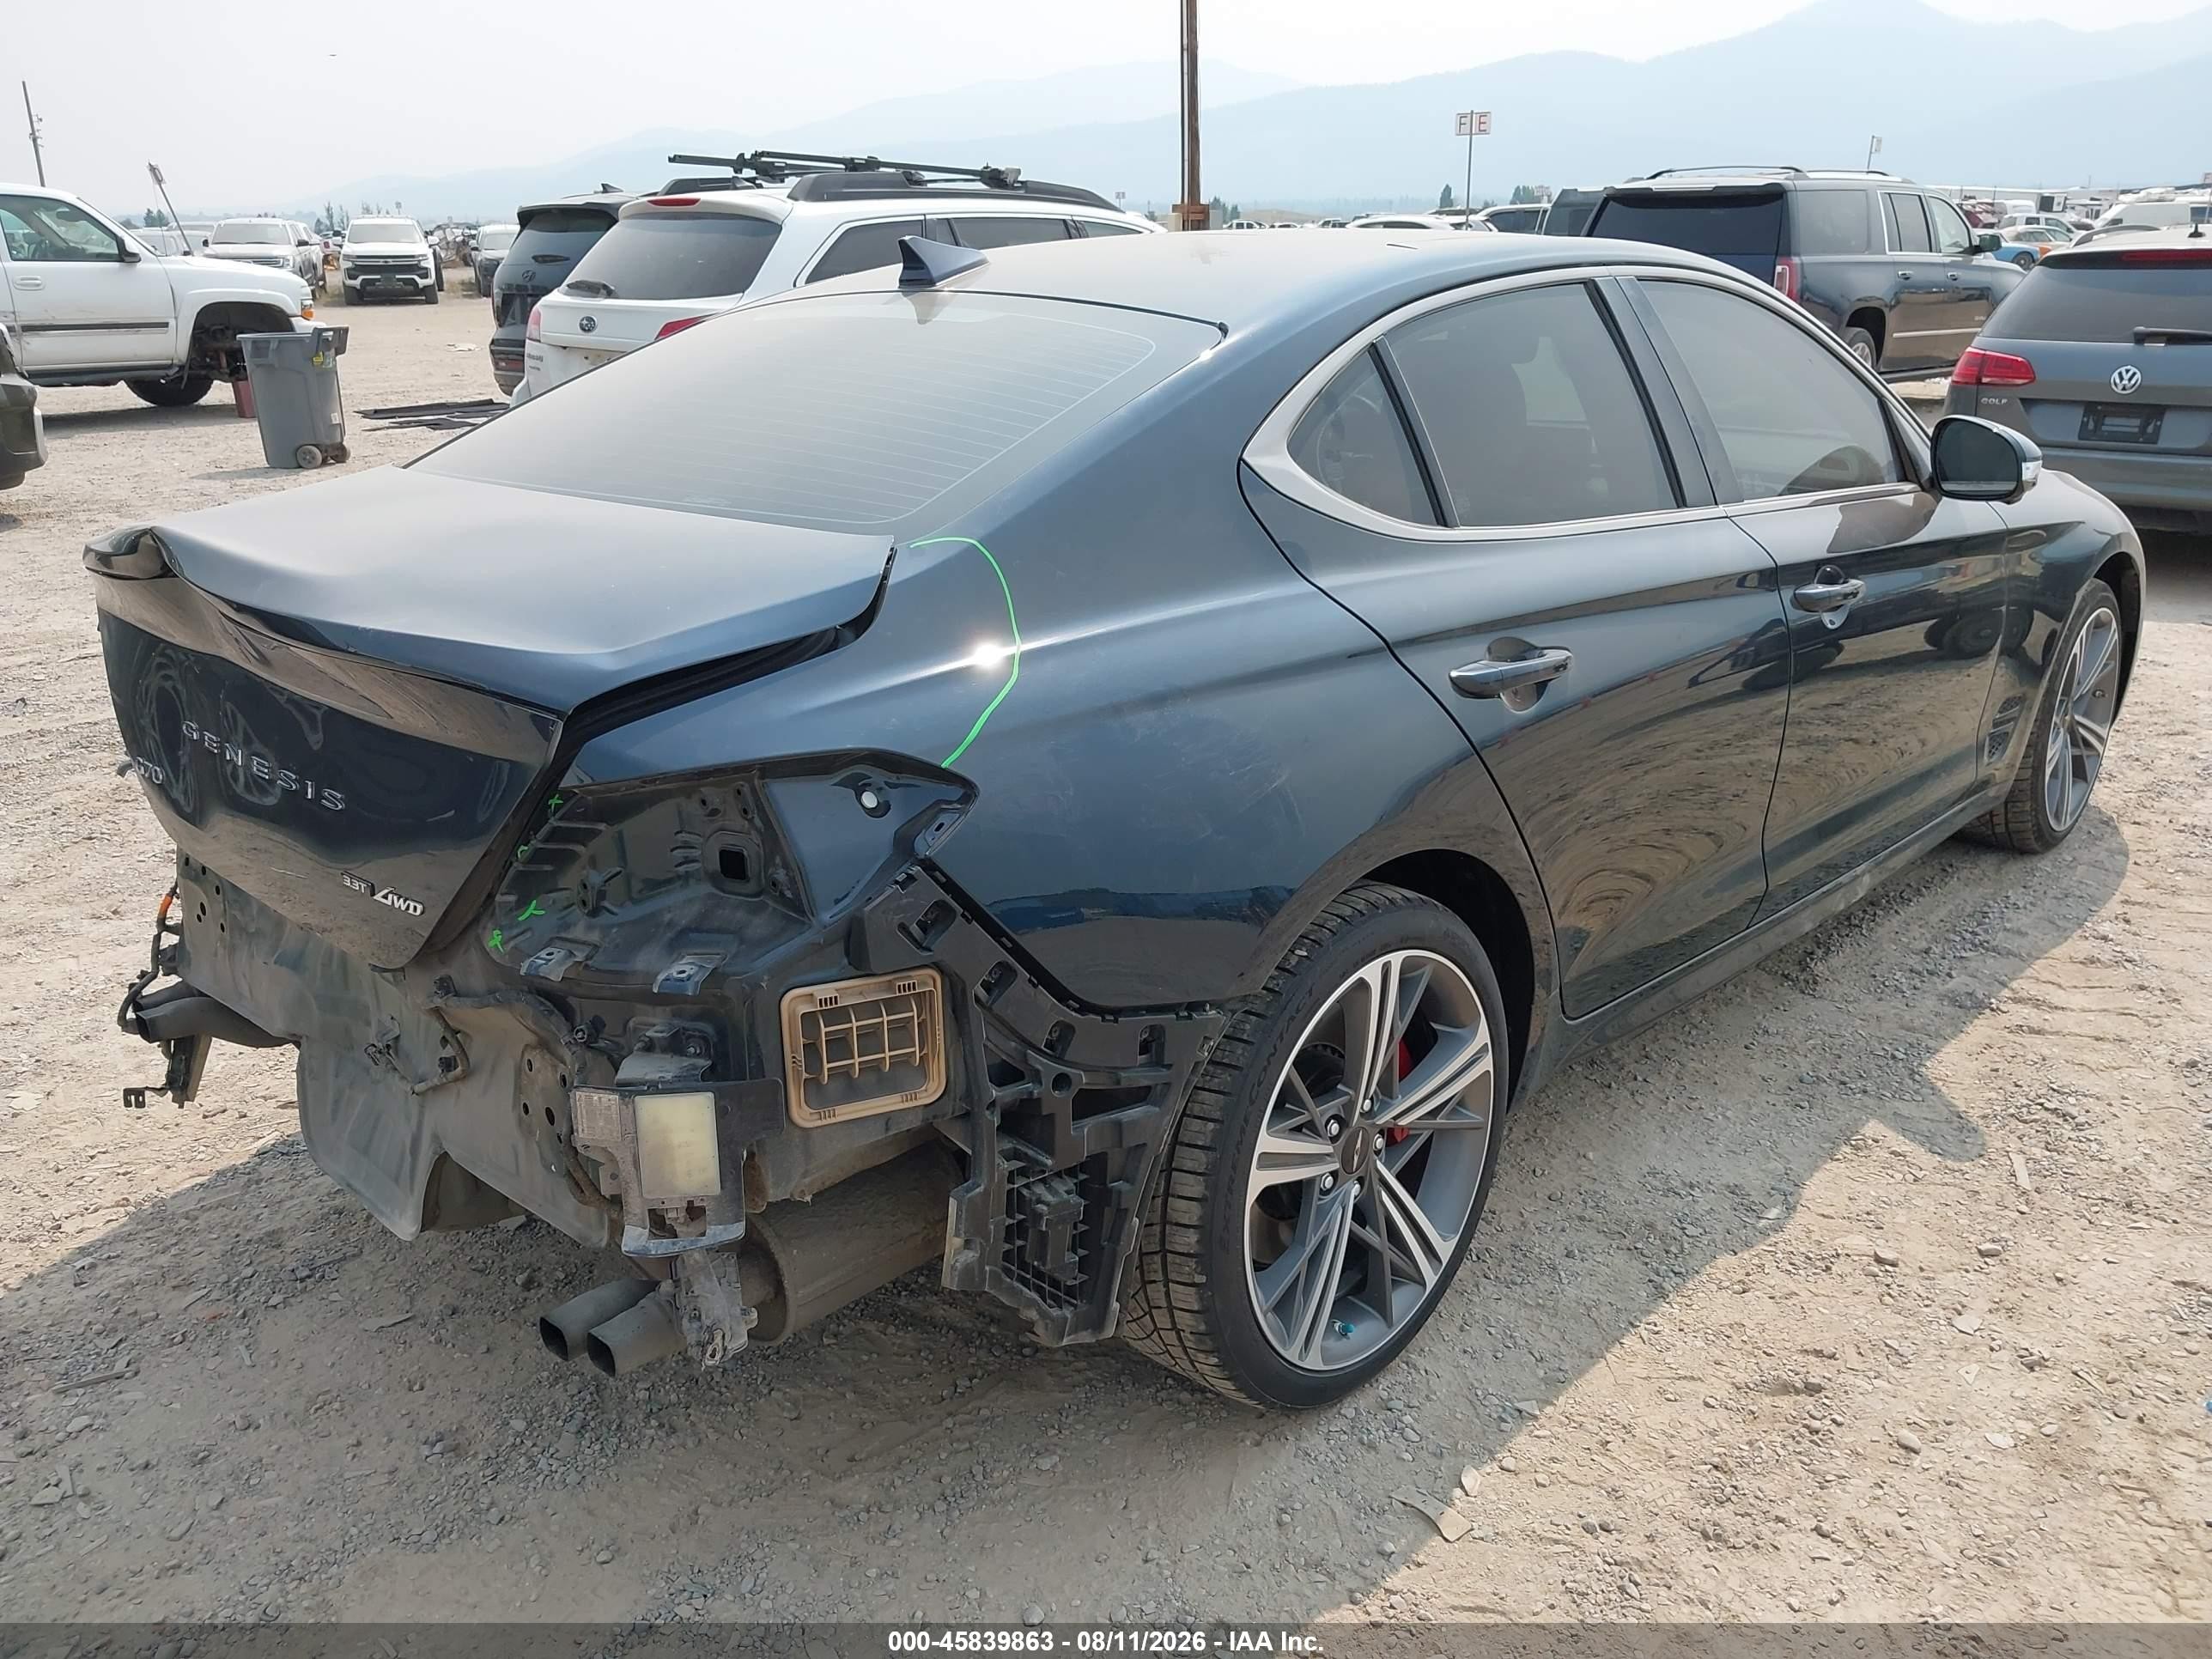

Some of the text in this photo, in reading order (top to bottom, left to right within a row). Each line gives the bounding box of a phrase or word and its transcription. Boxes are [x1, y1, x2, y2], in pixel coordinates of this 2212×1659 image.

[1459, 116, 1468, 133] F
[1478, 114, 1487, 132] E
[1980, 397, 2008, 405] GOLF
[135, 757, 163, 784] G70
[182, 720, 345, 811] GENESIS
